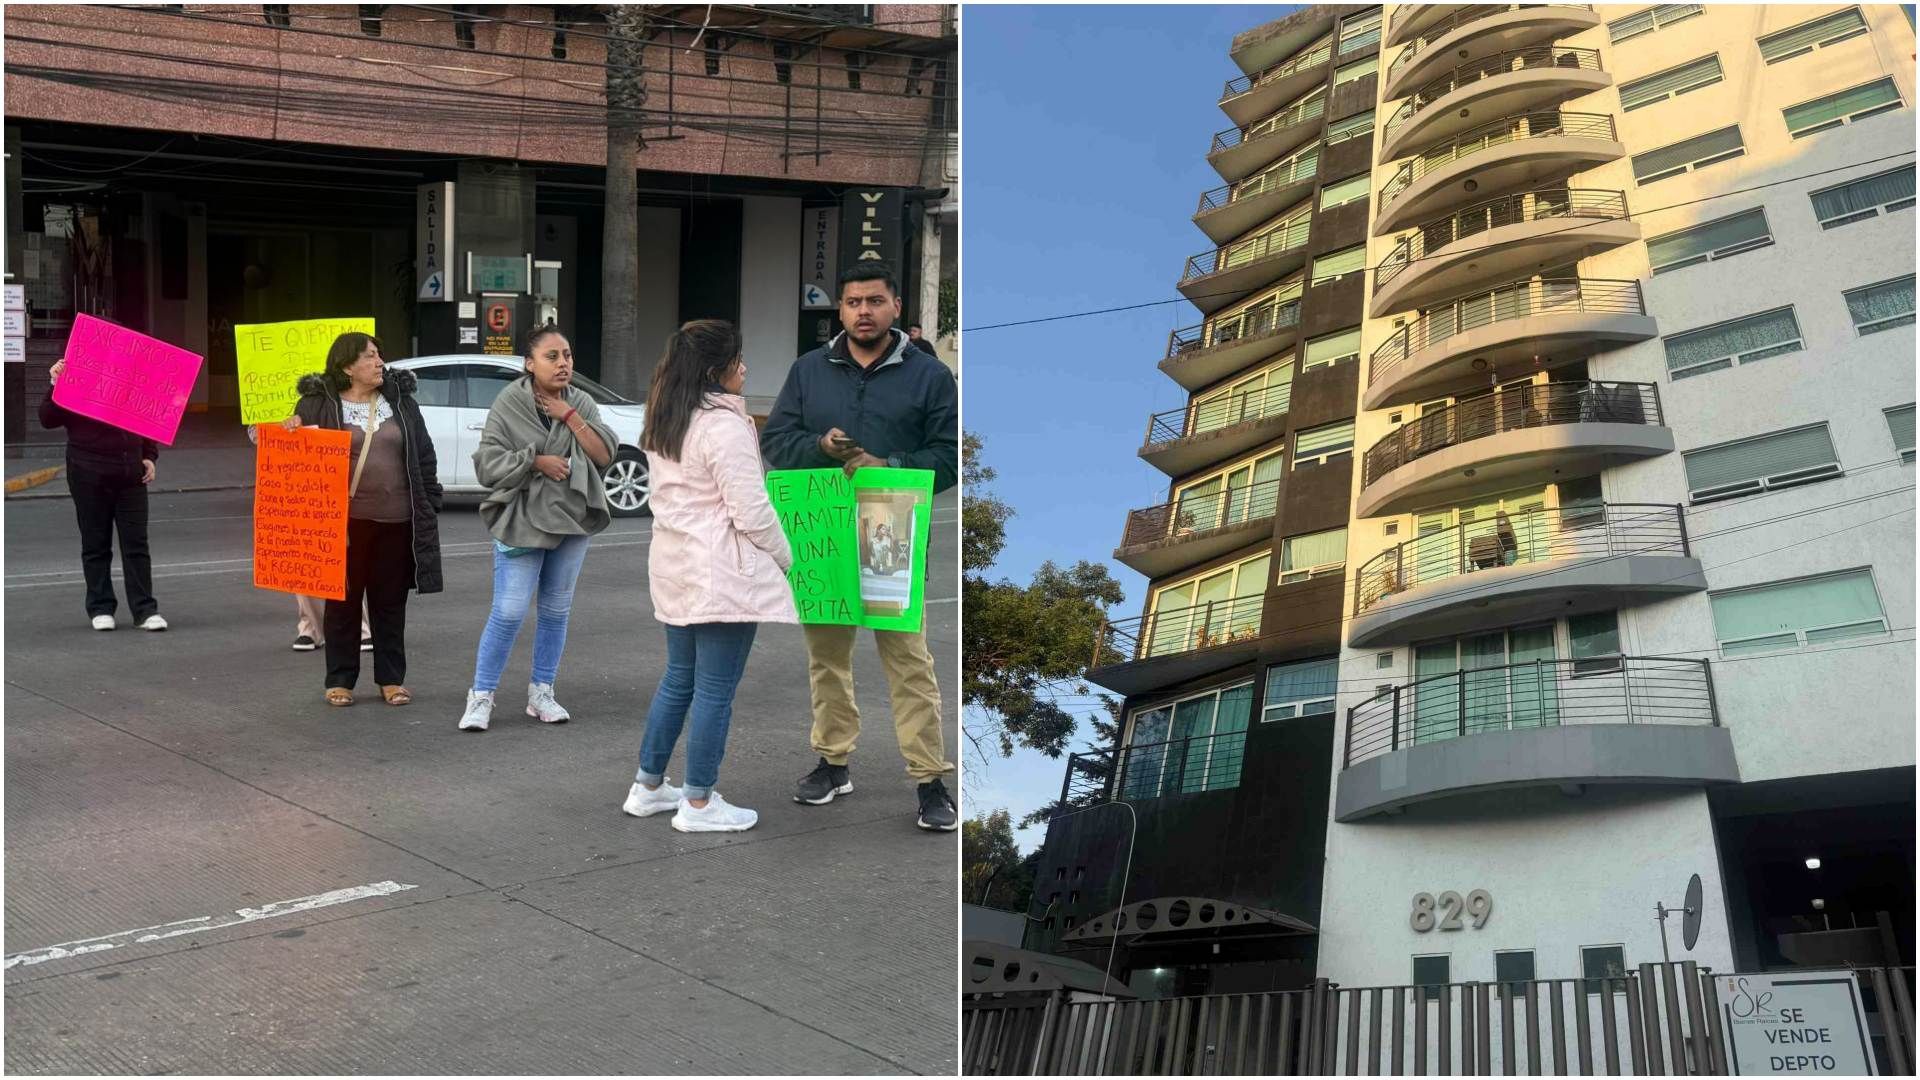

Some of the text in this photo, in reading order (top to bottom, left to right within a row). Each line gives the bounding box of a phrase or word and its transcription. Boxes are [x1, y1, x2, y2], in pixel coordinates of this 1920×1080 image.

[426, 189, 437, 268] SALIDA
[858, 192, 884, 260] VILLA
[816, 210, 827, 280] ENTRADA
[246, 329, 273, 353] TE
[244, 367, 308, 391] REGRES
[244, 390, 285, 407] EDITH
[261, 455, 274, 474] de
[325, 462, 337, 475] la
[768, 472, 850, 502] TE AMO
[798, 536, 841, 563] UNA
[799, 598, 855, 622] PITA
[1410, 889, 1493, 934] 829
[1781, 1008, 1805, 1023] SE
[1764, 1028, 1832, 1044] VENDE
[1770, 1055, 1836, 1071] DEPTO
